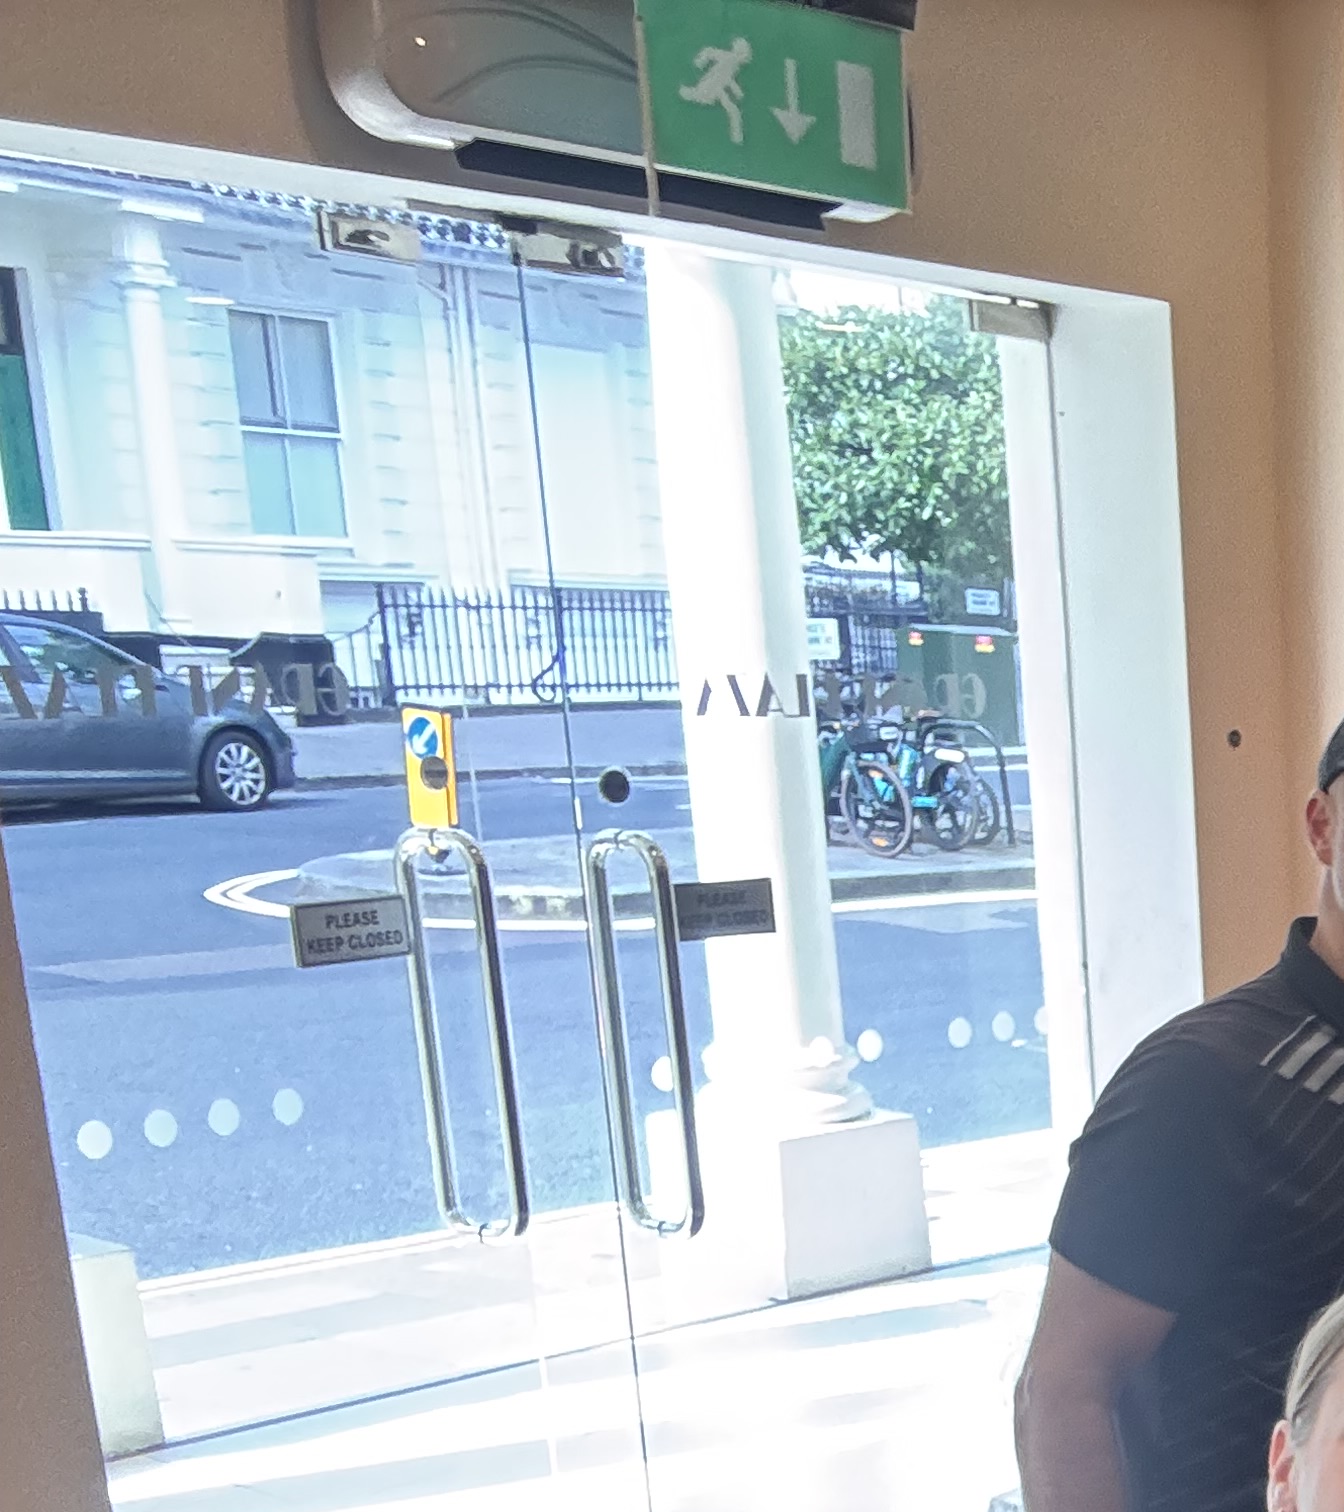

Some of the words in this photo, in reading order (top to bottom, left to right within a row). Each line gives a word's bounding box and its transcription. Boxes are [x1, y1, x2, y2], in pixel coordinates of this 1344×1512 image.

[325, 910, 380, 929] PLEASE
[306, 935, 345, 955] KEEP
[348, 929, 403, 950] CLOSED
